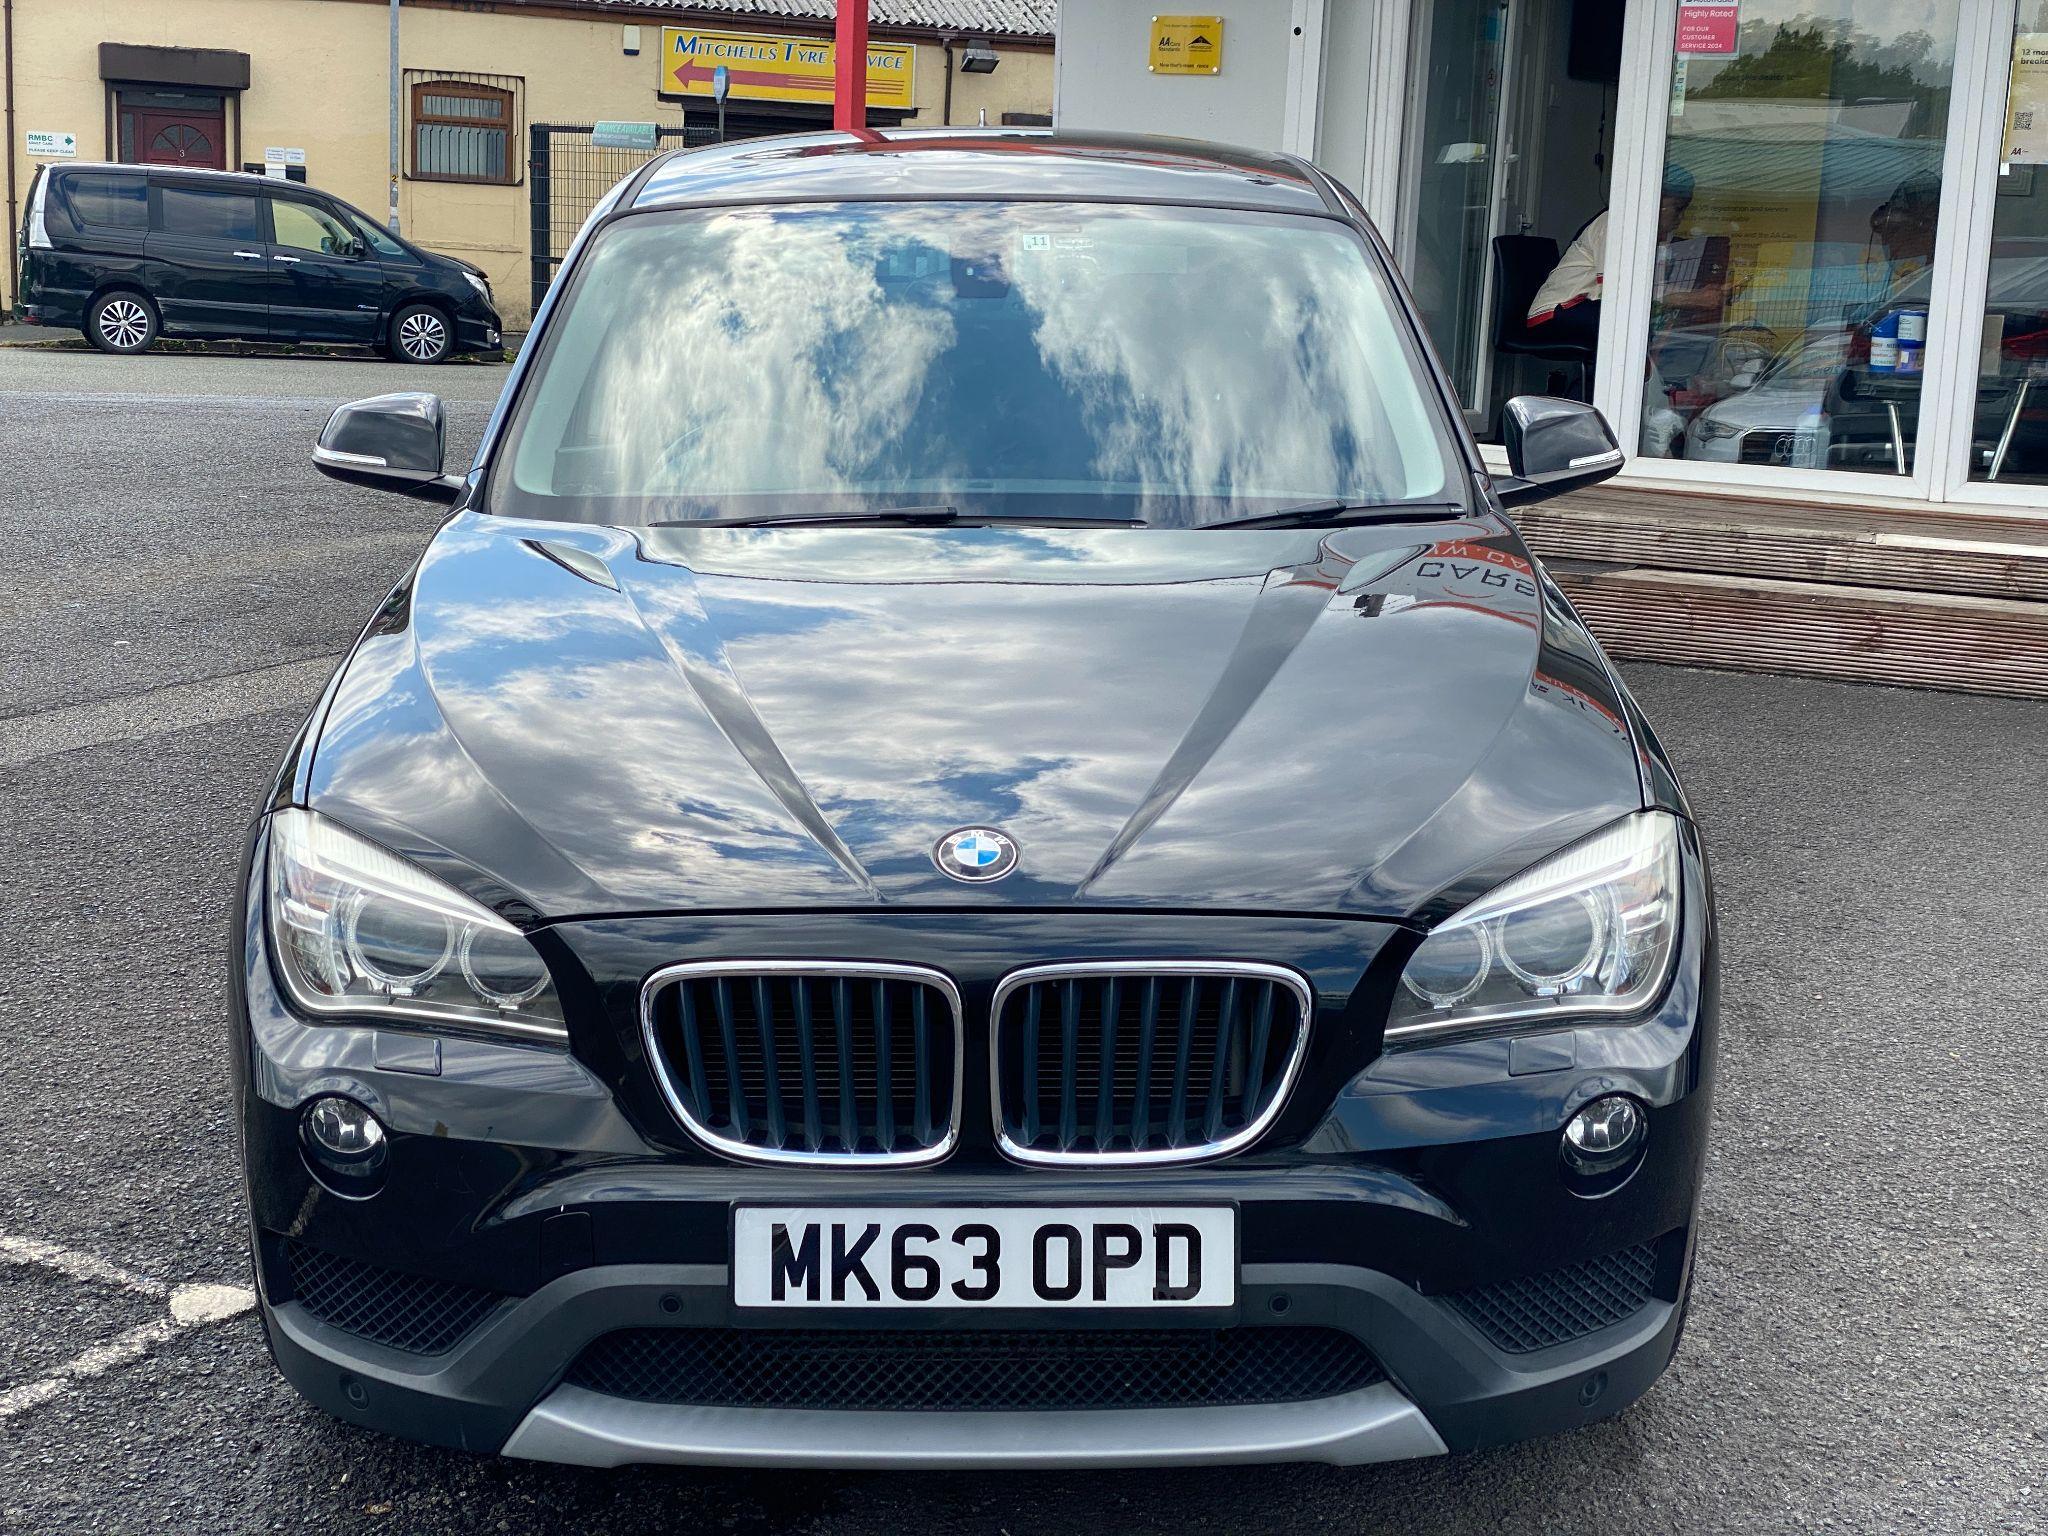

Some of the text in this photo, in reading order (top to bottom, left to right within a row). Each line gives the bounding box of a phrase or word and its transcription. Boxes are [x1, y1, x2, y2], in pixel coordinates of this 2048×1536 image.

[1684, 10, 1709, 18] Highly
[1159, 37, 1170, 46] AA
[180, 149, 185, 158] 3
[2011, 147, 2022, 155] AA
[1031, 236, 1047, 246] 11
[946, 830, 1011, 845] BMW
[771, 1223, 1202, 1302] MK63 OPD
